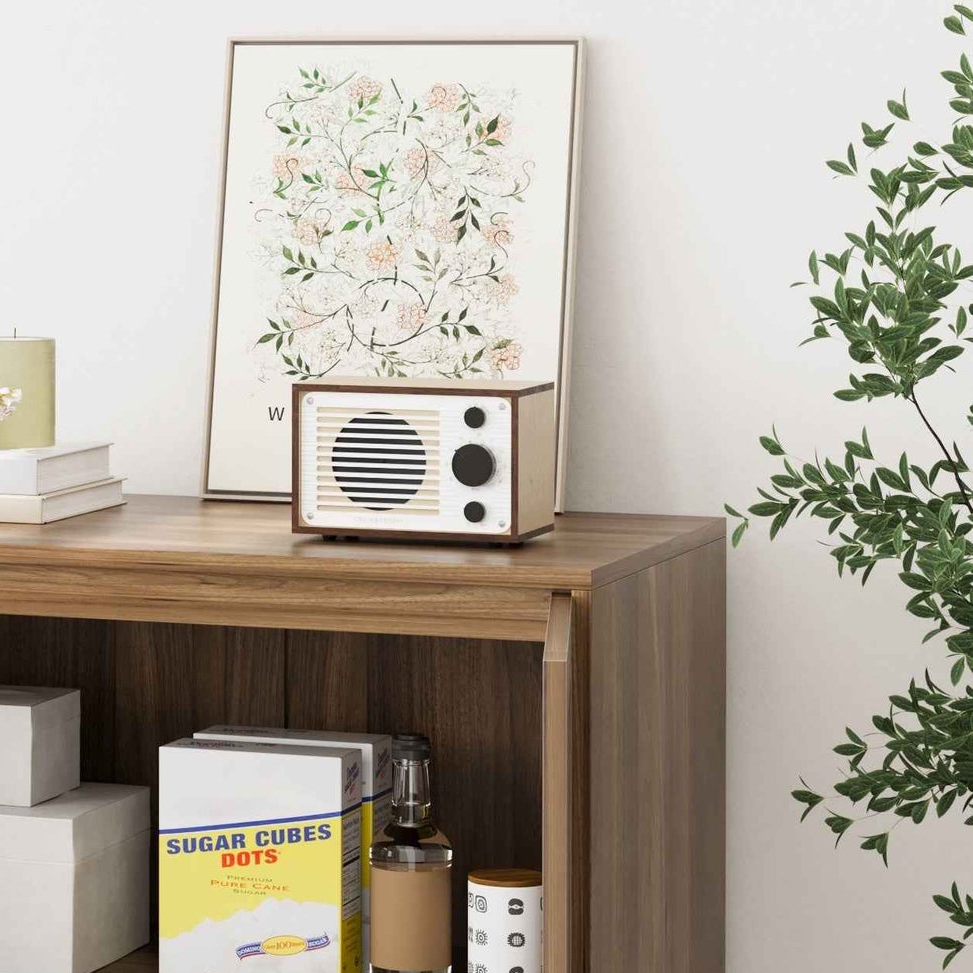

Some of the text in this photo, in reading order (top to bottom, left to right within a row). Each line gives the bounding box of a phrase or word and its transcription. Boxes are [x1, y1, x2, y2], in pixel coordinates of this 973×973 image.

[167, 824, 332, 855] SUGAR CUBES
[221, 849, 278, 868] DOTS
